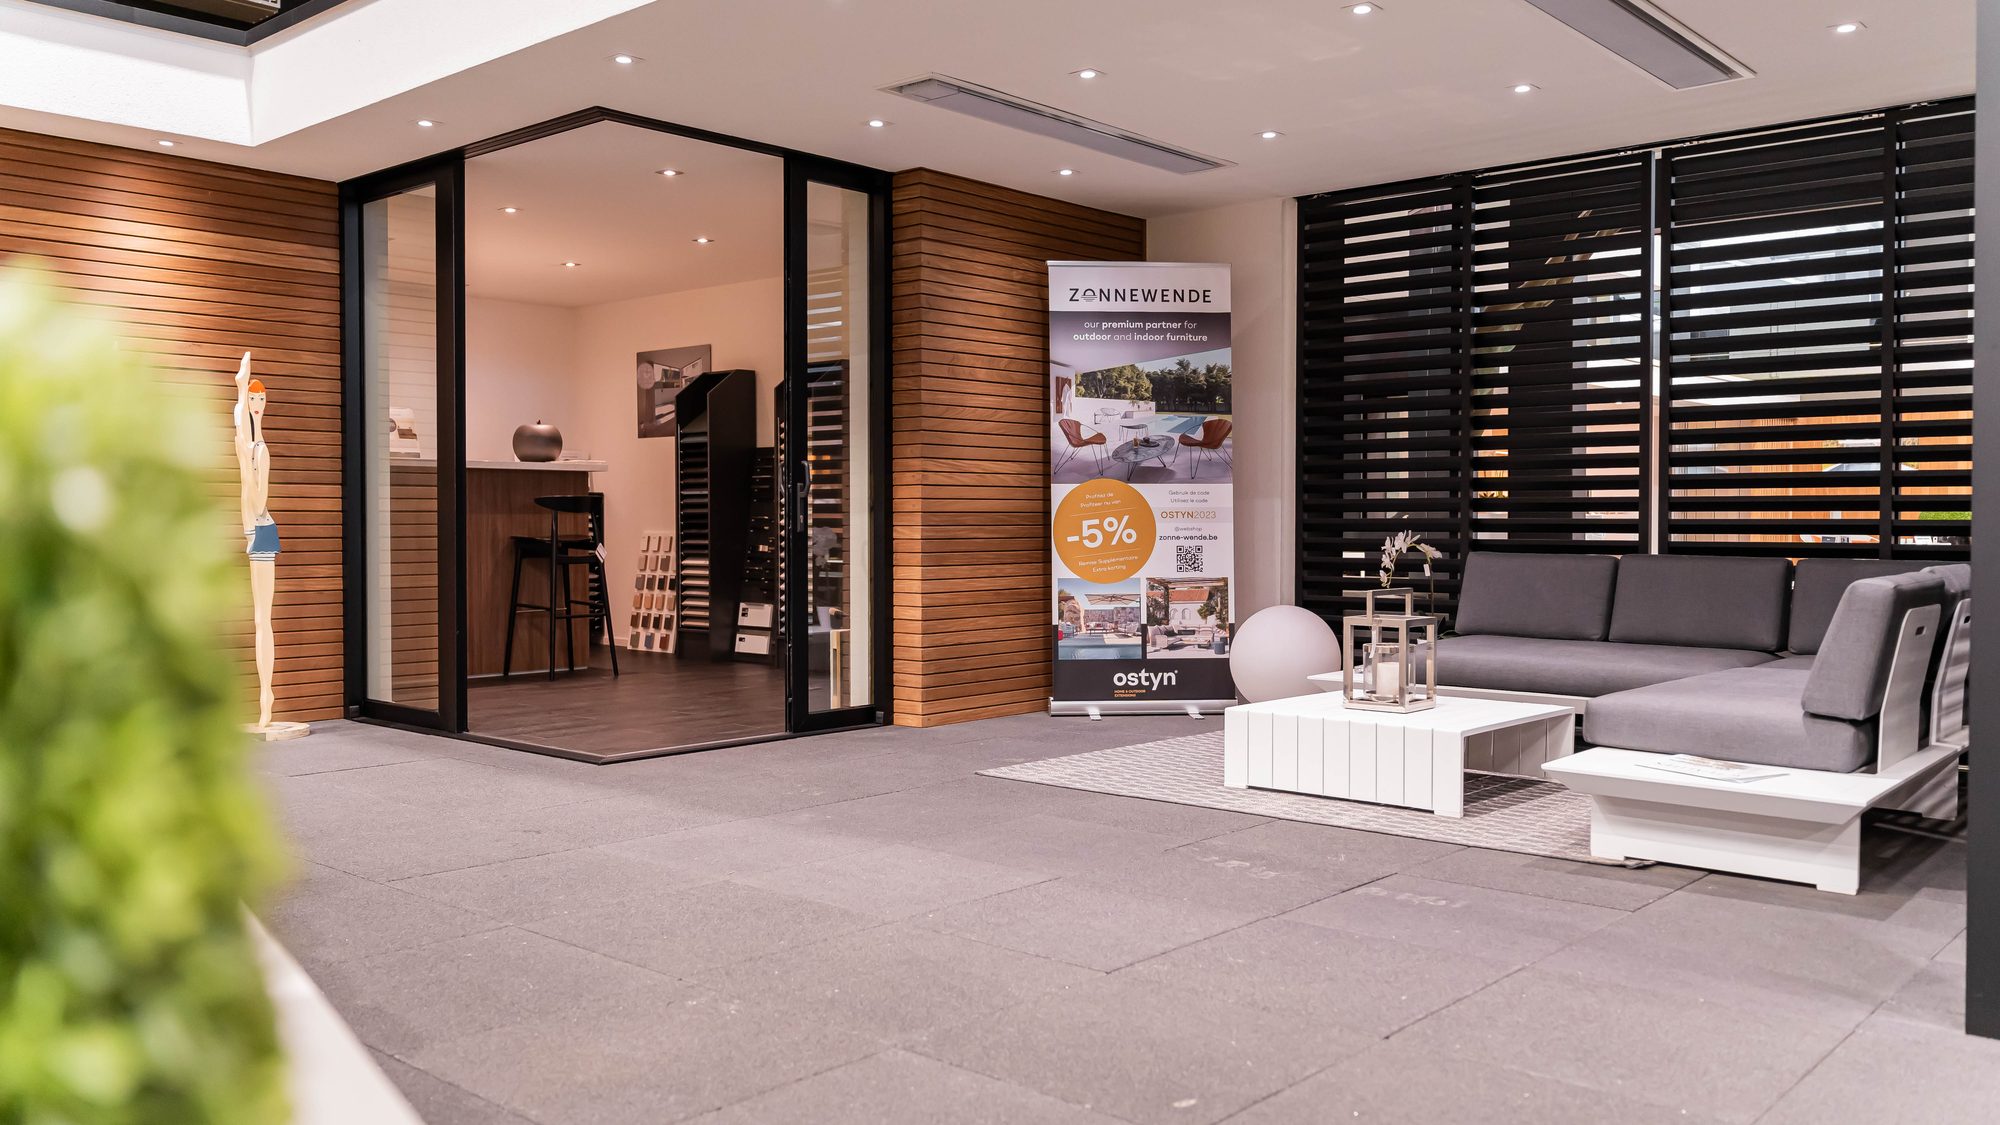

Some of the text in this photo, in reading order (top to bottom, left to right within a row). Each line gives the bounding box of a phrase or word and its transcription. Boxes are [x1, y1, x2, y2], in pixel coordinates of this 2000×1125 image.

[1069, 288, 1212, 303] ZONNEWENDE
[1102, 320, 1144, 331] premium
[1145, 321, 1182, 331] partner
[1184, 320, 1197, 330] for
[1073, 333, 1208, 342] outdoor and indoor furniture
[1160, 511, 1217, 520] OSTYN2023
[1066, 515, 1137, 548] -5%
